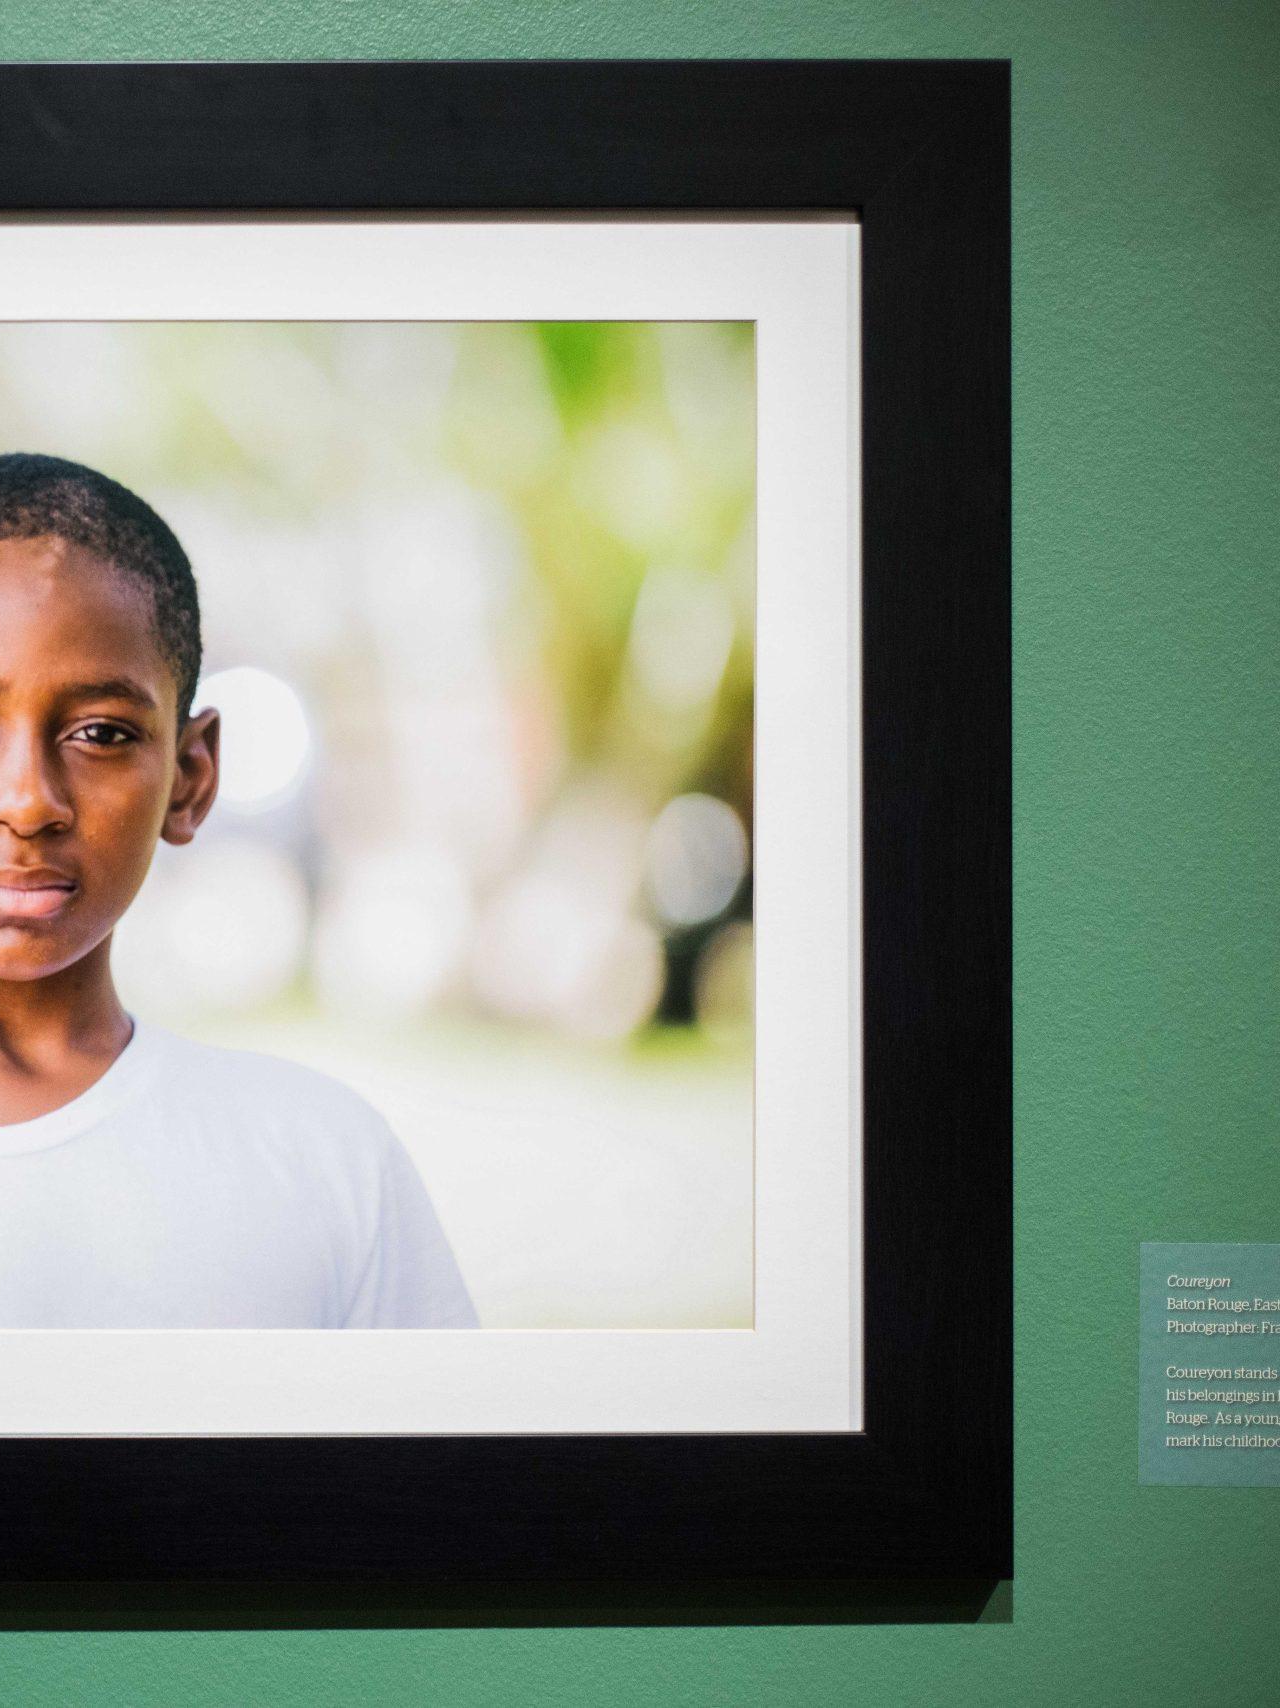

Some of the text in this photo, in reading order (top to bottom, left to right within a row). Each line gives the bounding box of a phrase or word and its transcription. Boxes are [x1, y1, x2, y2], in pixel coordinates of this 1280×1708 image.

[1167, 1274, 1231, 1289] Coureyon
[1167, 1298, 1205, 1310] Baton
[1208, 1298, 1252, 1312] Rouge,
[1167, 1320, 1259, 1335] Photographer:
[1166, 1366, 1278, 1381] Coureyon stands
[1166, 1389, 1186, 1401] his
[1188, 1389, 1260, 1404] belongings
[1262, 1389, 1275, 1401] in
[1166, 1412, 1280, 1426] Rouge. As a youn
[1166, 1435, 1200, 1447] mark
[1202, 1435, 1222, 1447] his
